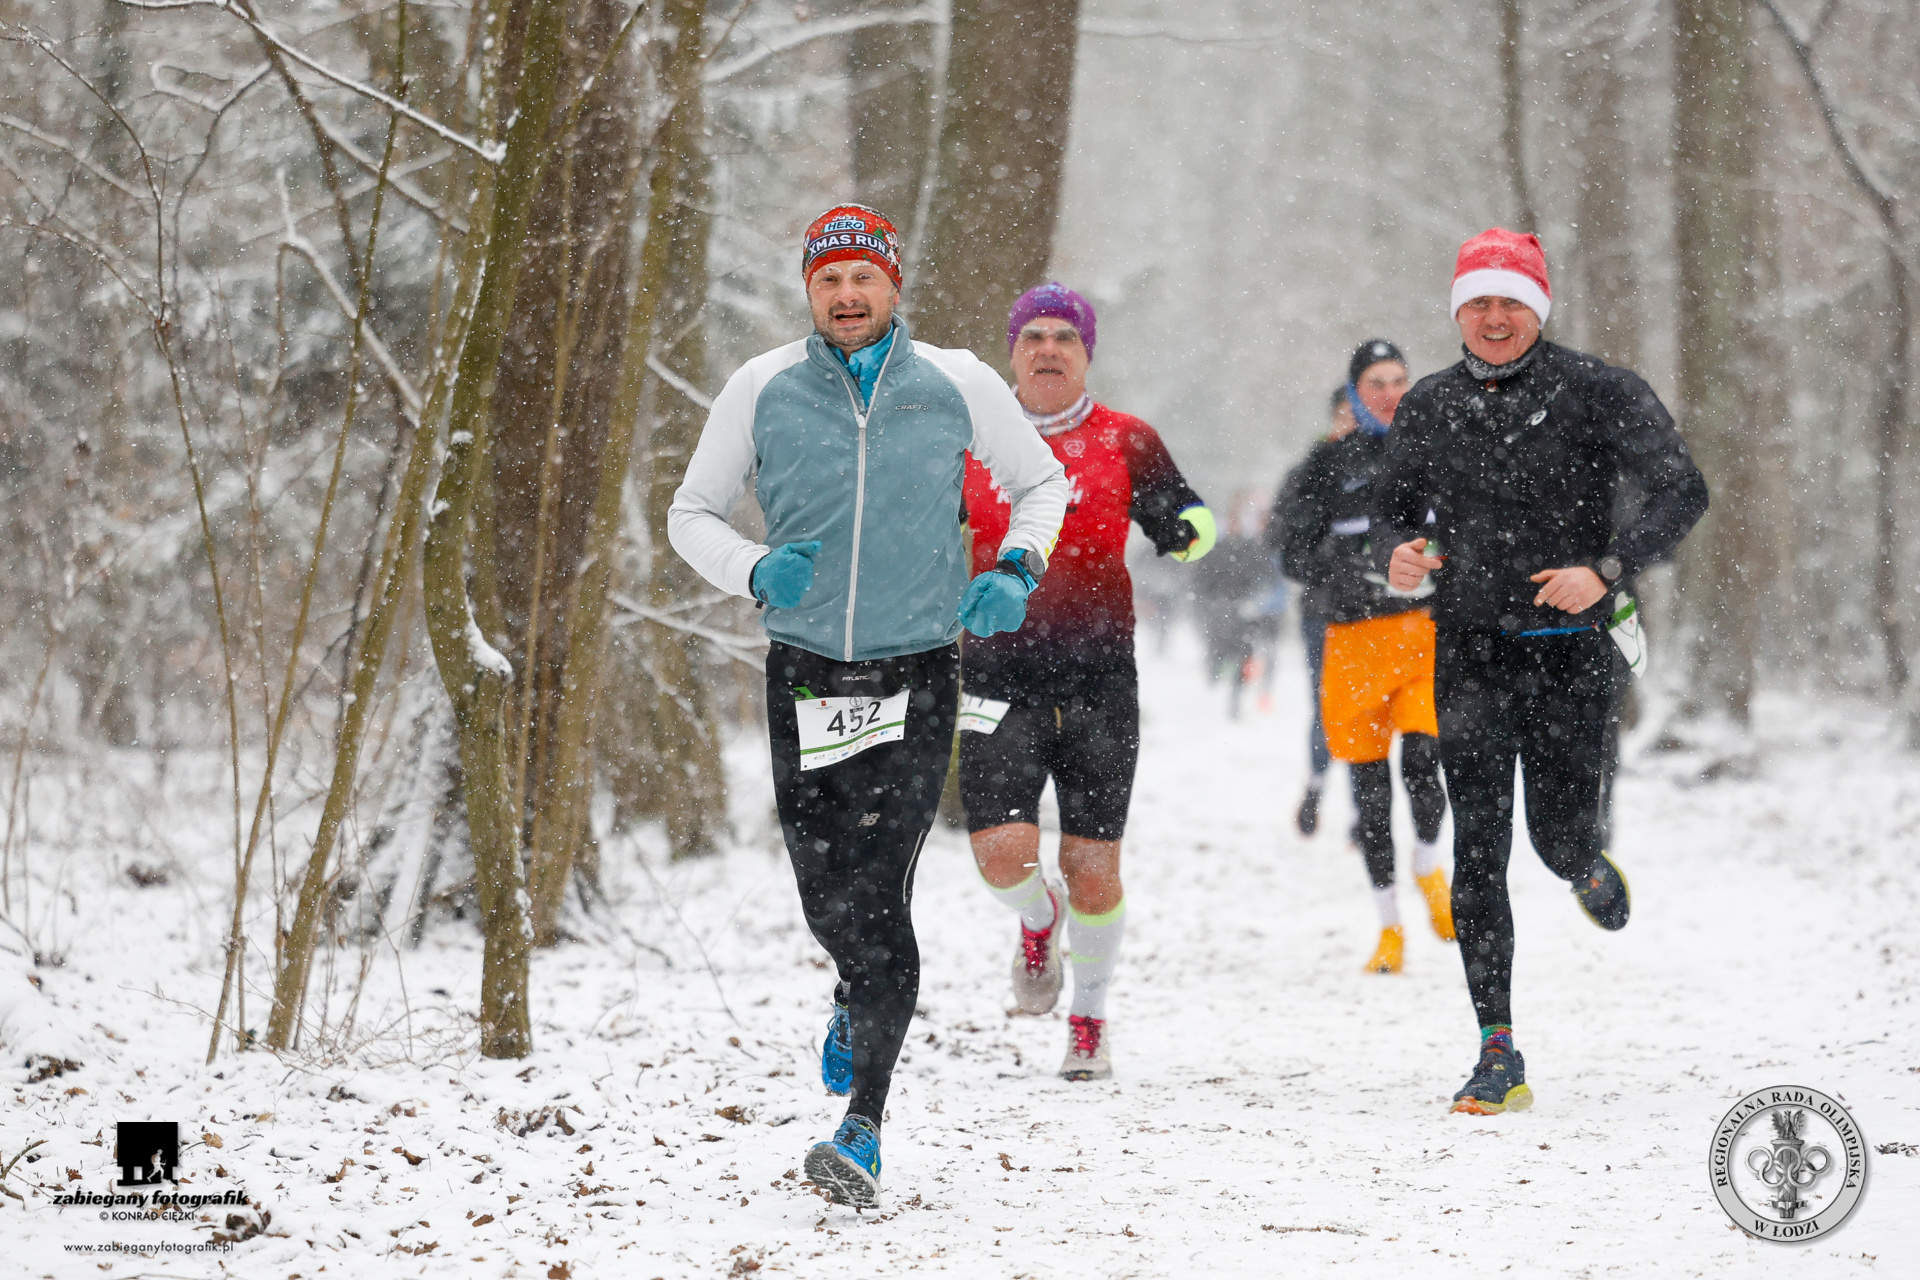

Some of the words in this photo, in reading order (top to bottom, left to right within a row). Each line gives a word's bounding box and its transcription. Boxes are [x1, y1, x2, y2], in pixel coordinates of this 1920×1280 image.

[827, 221, 863, 231] HERO
[808, 234, 852, 256] XMAS
[855, 234, 886, 254] RUN
[827, 701, 881, 736] 452
